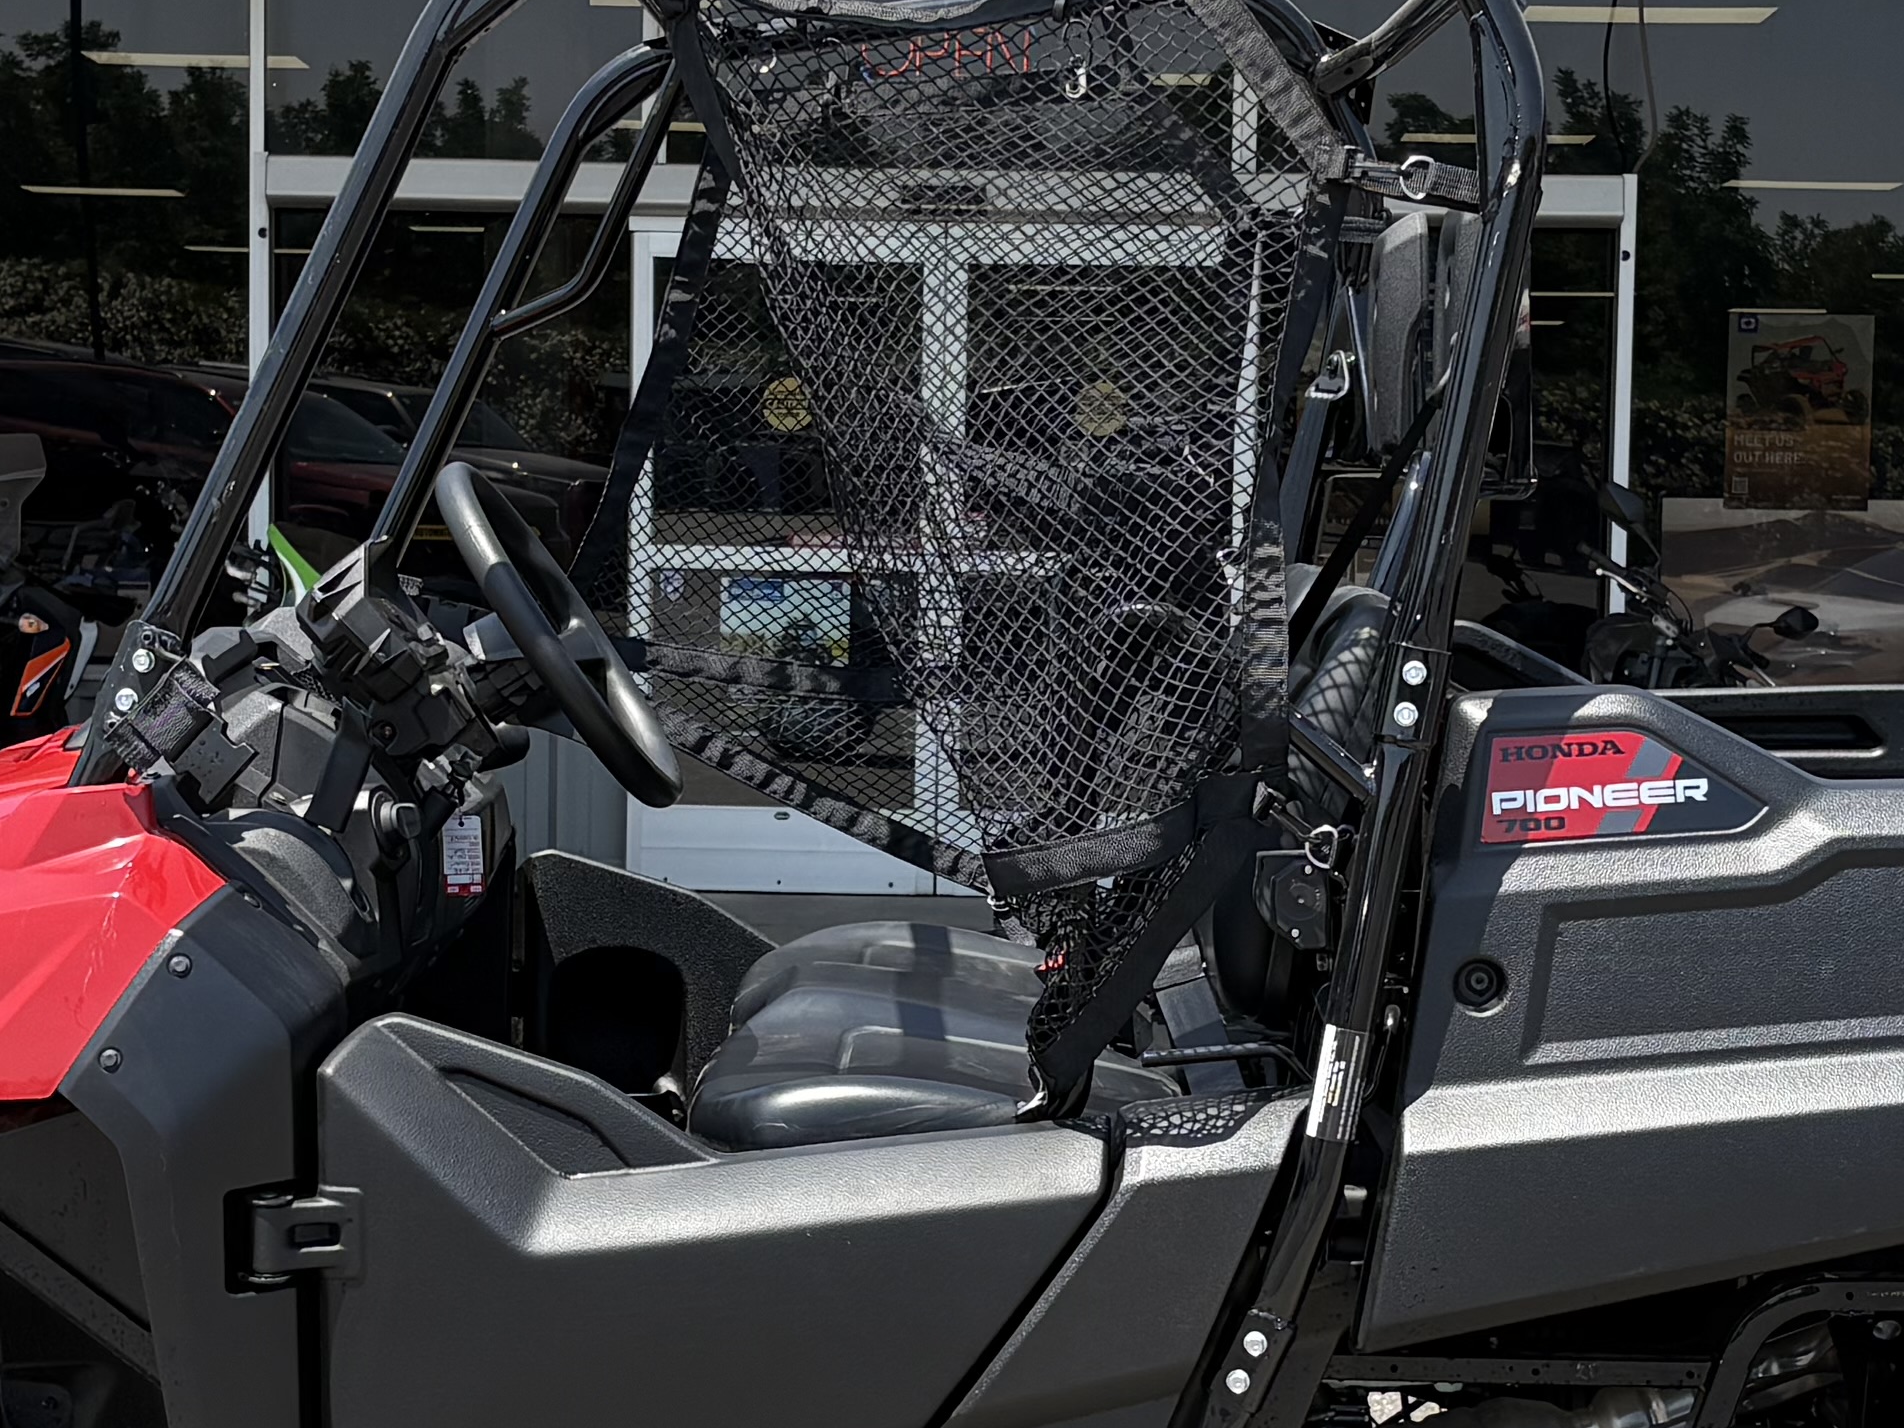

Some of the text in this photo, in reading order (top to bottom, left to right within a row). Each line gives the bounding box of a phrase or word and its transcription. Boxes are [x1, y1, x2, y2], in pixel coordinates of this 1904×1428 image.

[1499, 740, 1625, 763] HONDA
[1491, 778, 1708, 815] PIONEER
[1496, 816, 1566, 833] 700
